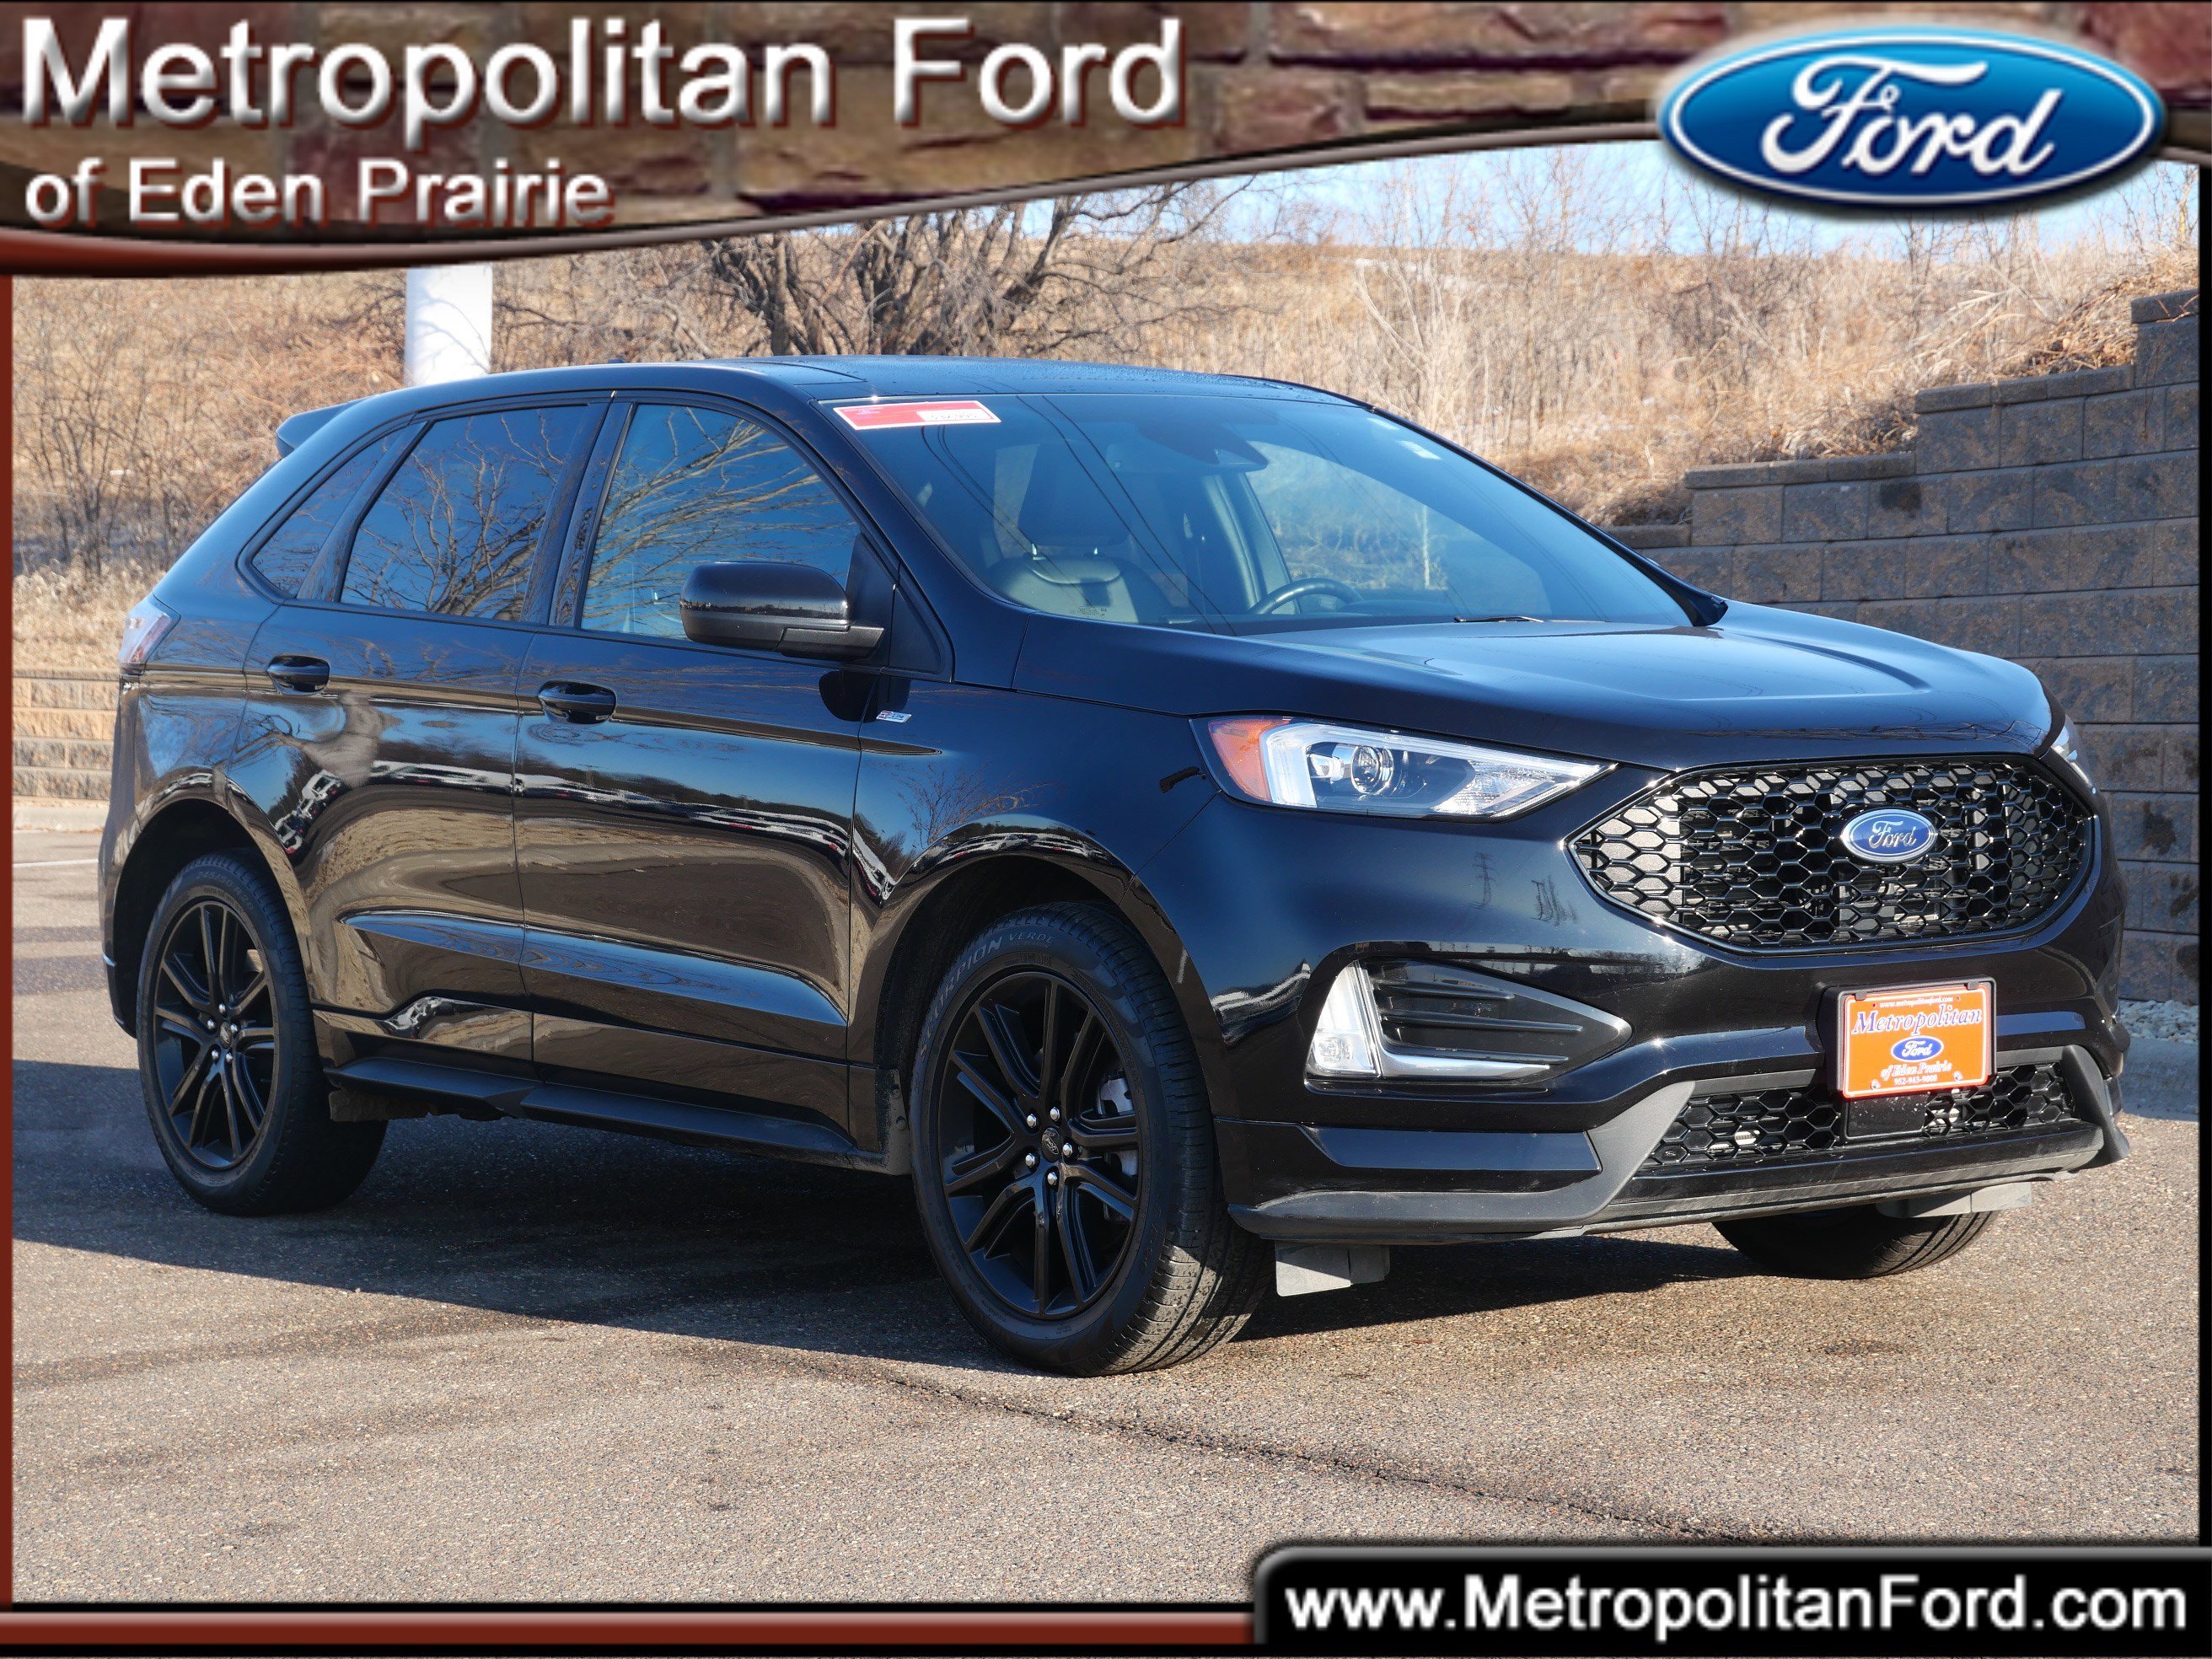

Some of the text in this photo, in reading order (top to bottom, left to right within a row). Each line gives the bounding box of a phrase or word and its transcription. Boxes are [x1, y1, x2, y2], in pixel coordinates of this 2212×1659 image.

[1869, 820, 1917, 849] Ford
[1851, 1004, 1983, 1035] Metropolitan
[1902, 1040, 1932, 1057] Ford
[1881, 1060, 1952, 1081] of Eden Prairie
